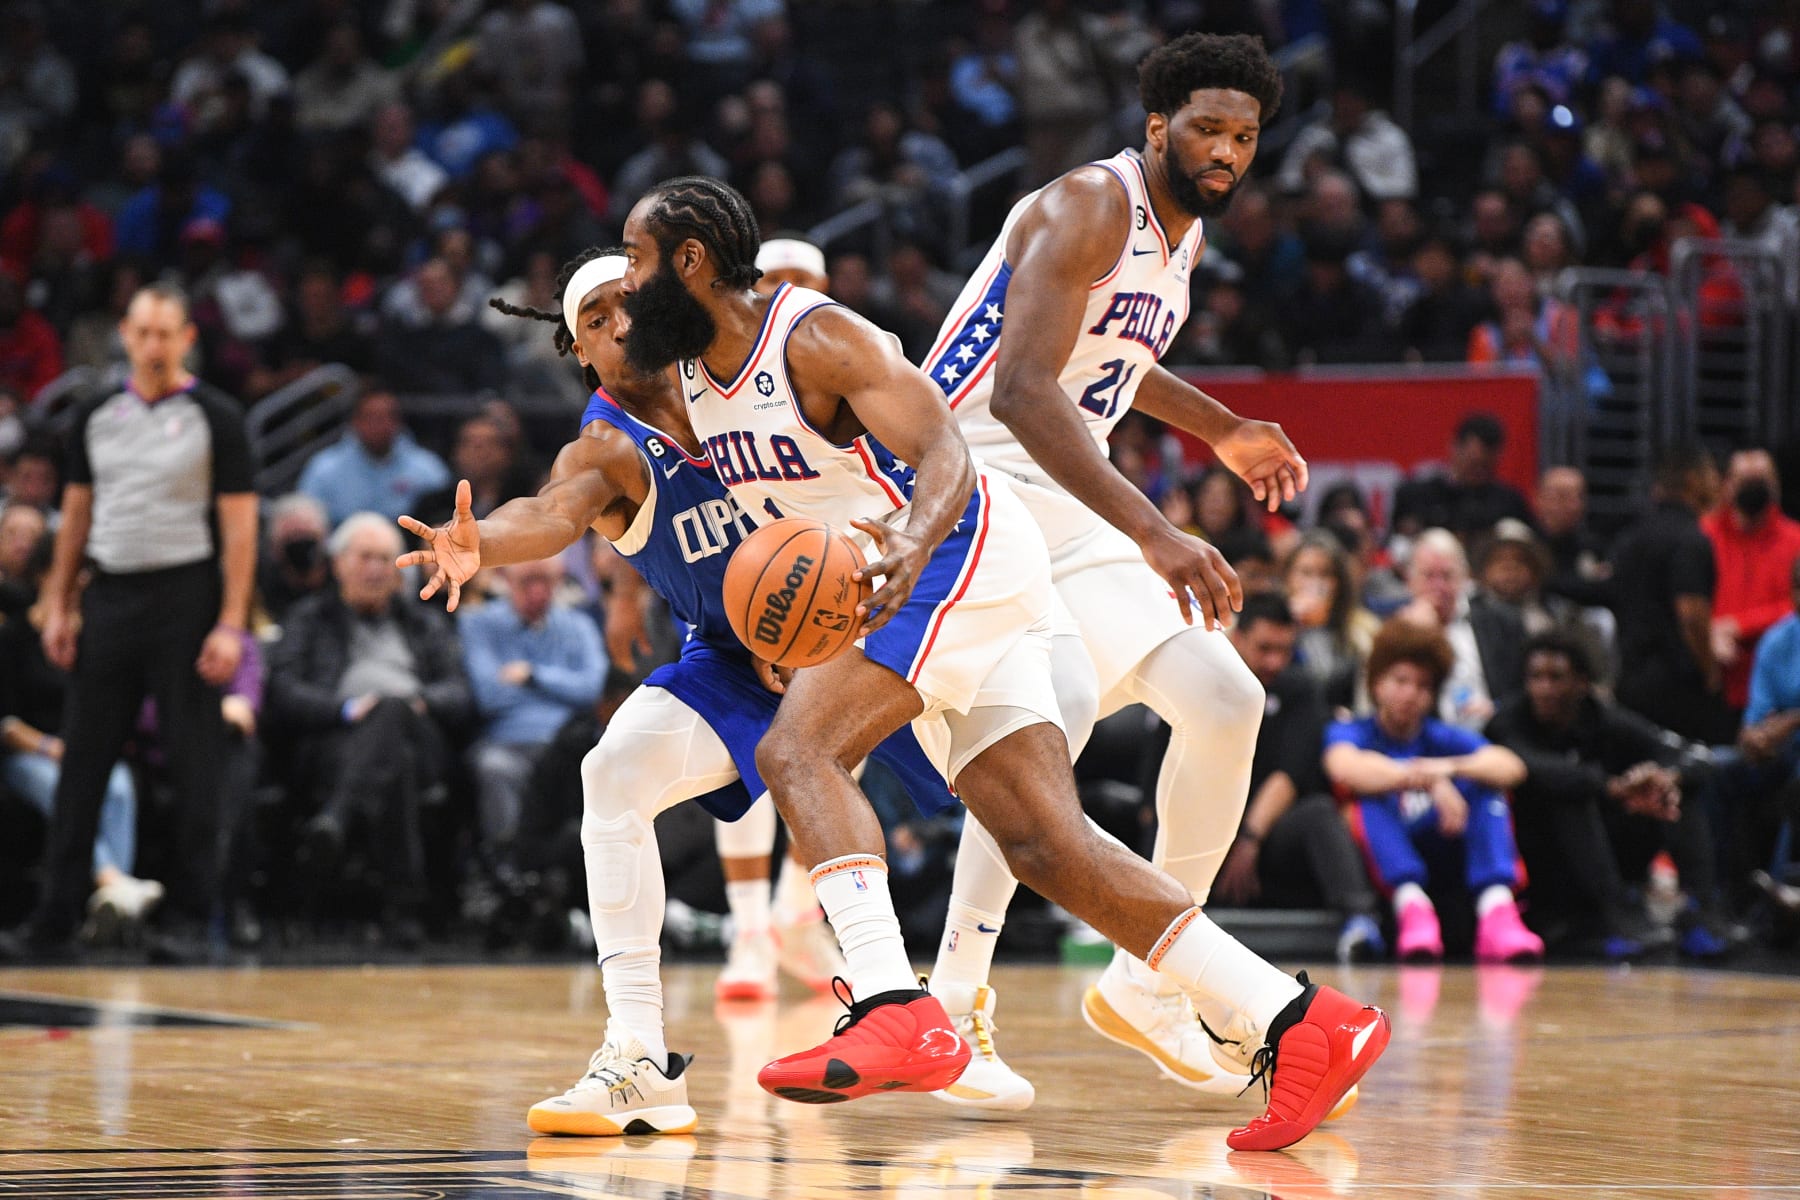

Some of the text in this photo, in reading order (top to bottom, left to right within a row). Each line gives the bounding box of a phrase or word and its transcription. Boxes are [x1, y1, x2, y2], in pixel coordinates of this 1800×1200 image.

[1135, 206, 1146, 229] 6
[1088, 291, 1175, 363] PHILA
[753, 399, 788, 411] crypto.com
[1078, 358, 1137, 419] 21
[646, 438, 665, 458] 6
[755, 555, 815, 645] Wilson
